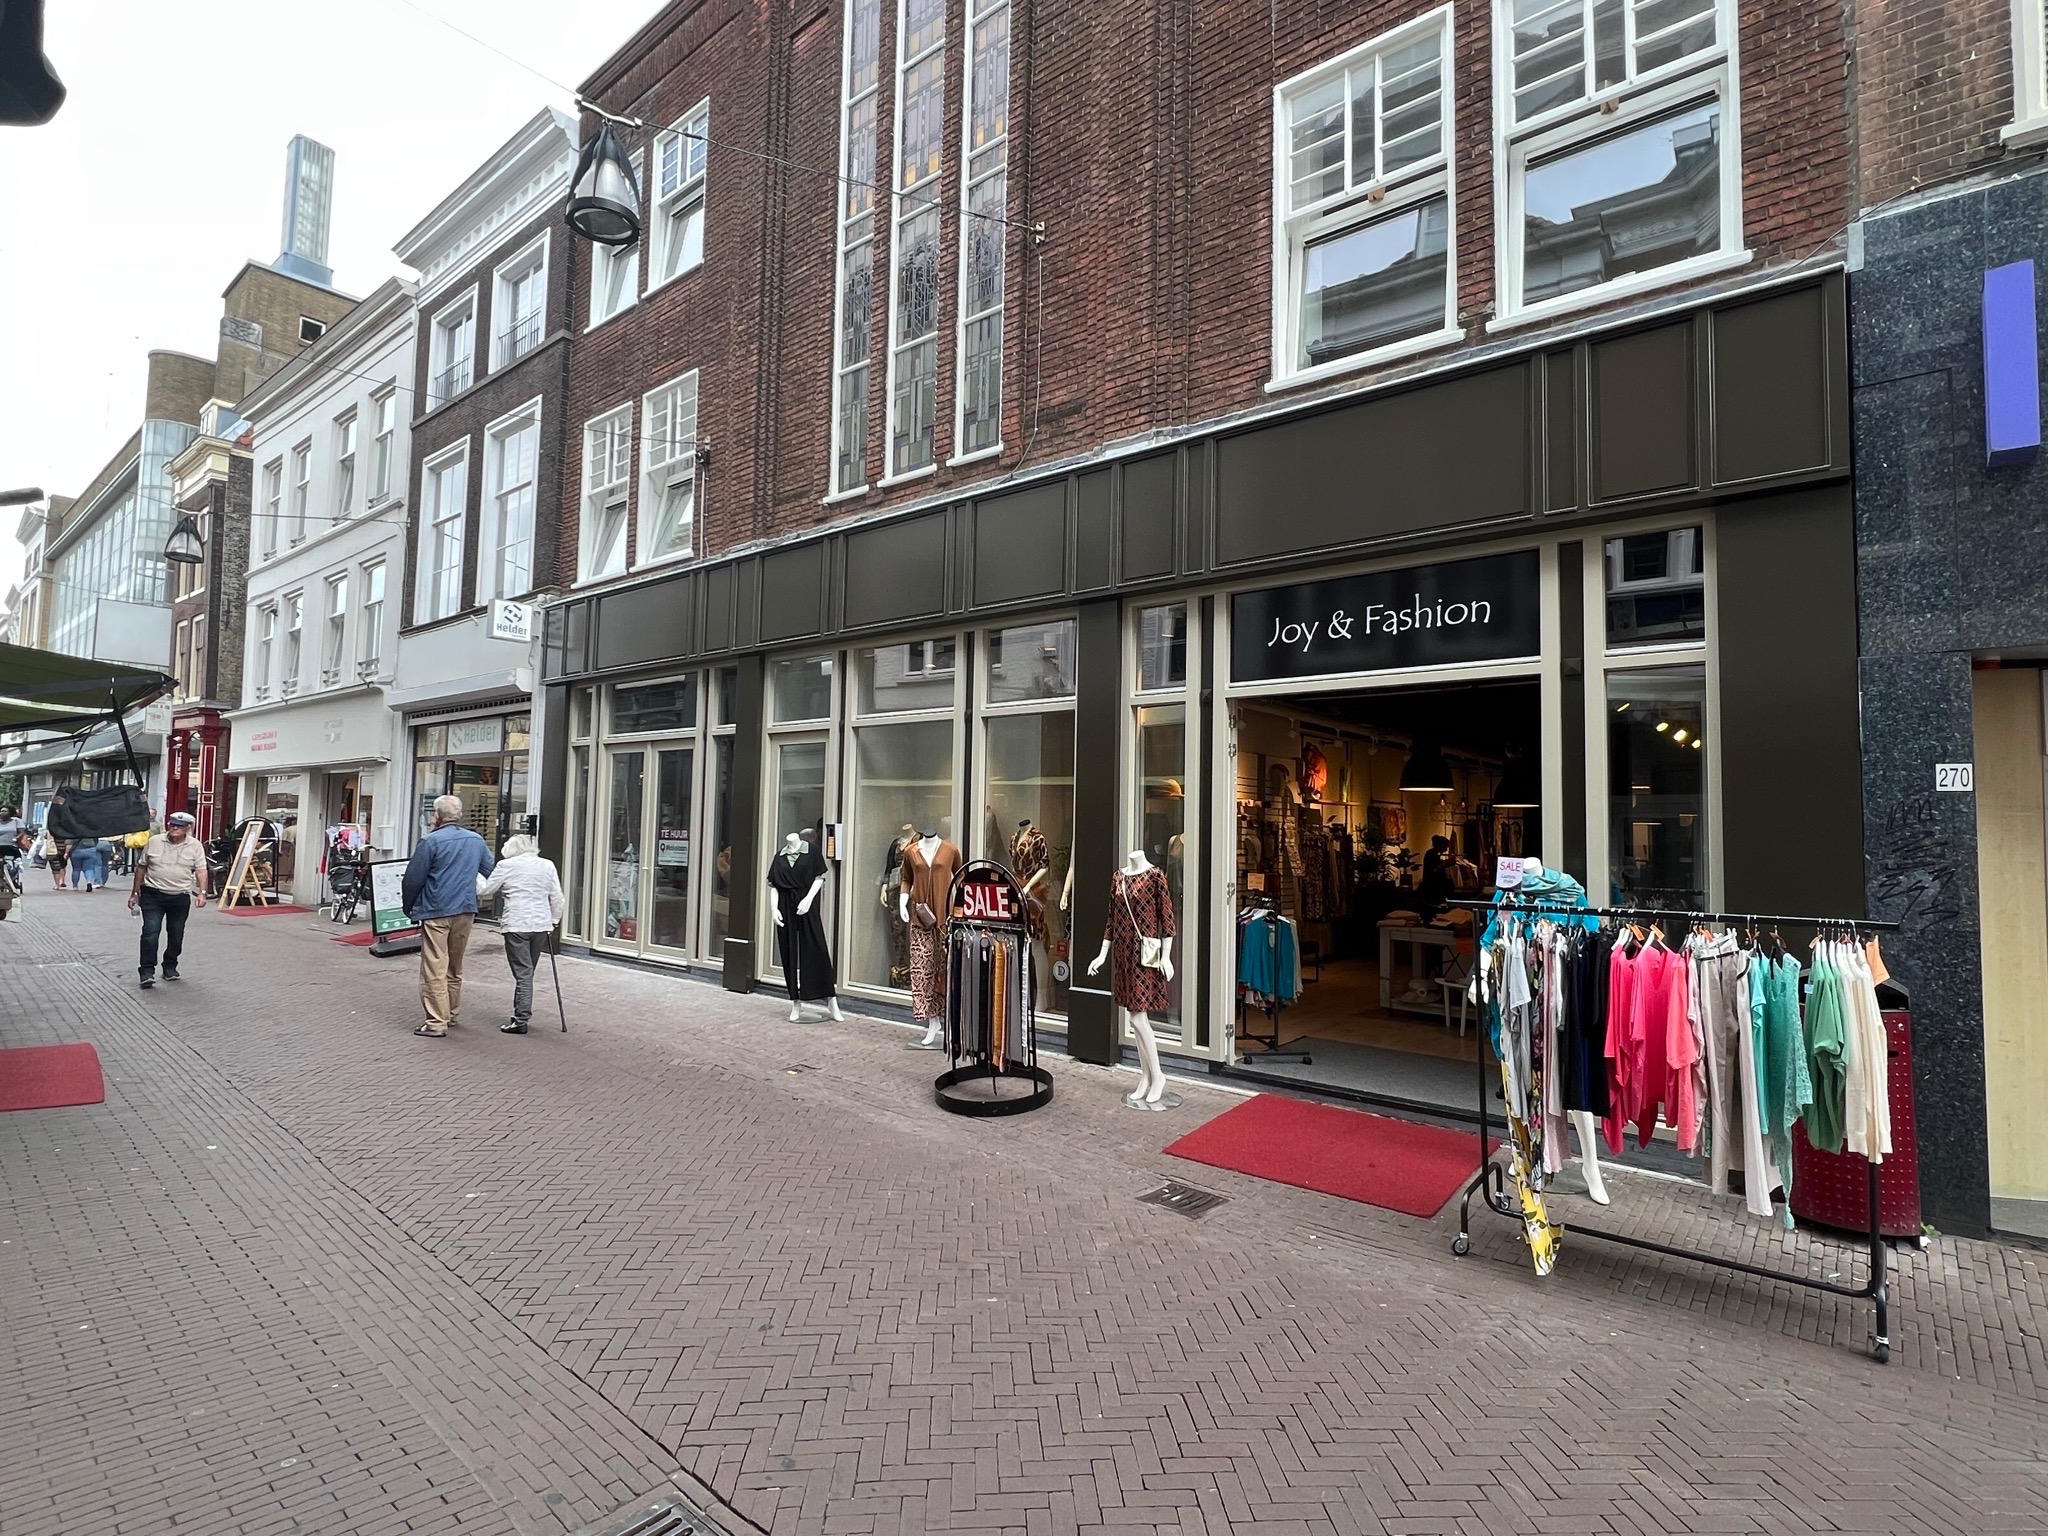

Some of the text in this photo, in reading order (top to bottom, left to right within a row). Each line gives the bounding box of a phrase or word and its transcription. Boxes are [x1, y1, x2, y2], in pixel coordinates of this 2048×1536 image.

[496, 623, 528, 635] Helder
[1267, 593, 1491, 652] Joy & Fashion
[464, 724, 497, 744] Helder
[1938, 767, 1970, 787] 270
[661, 829, 689, 839] TE HUUR
[1500, 861, 1522, 872] SALE
[963, 884, 1011, 918] SALE
